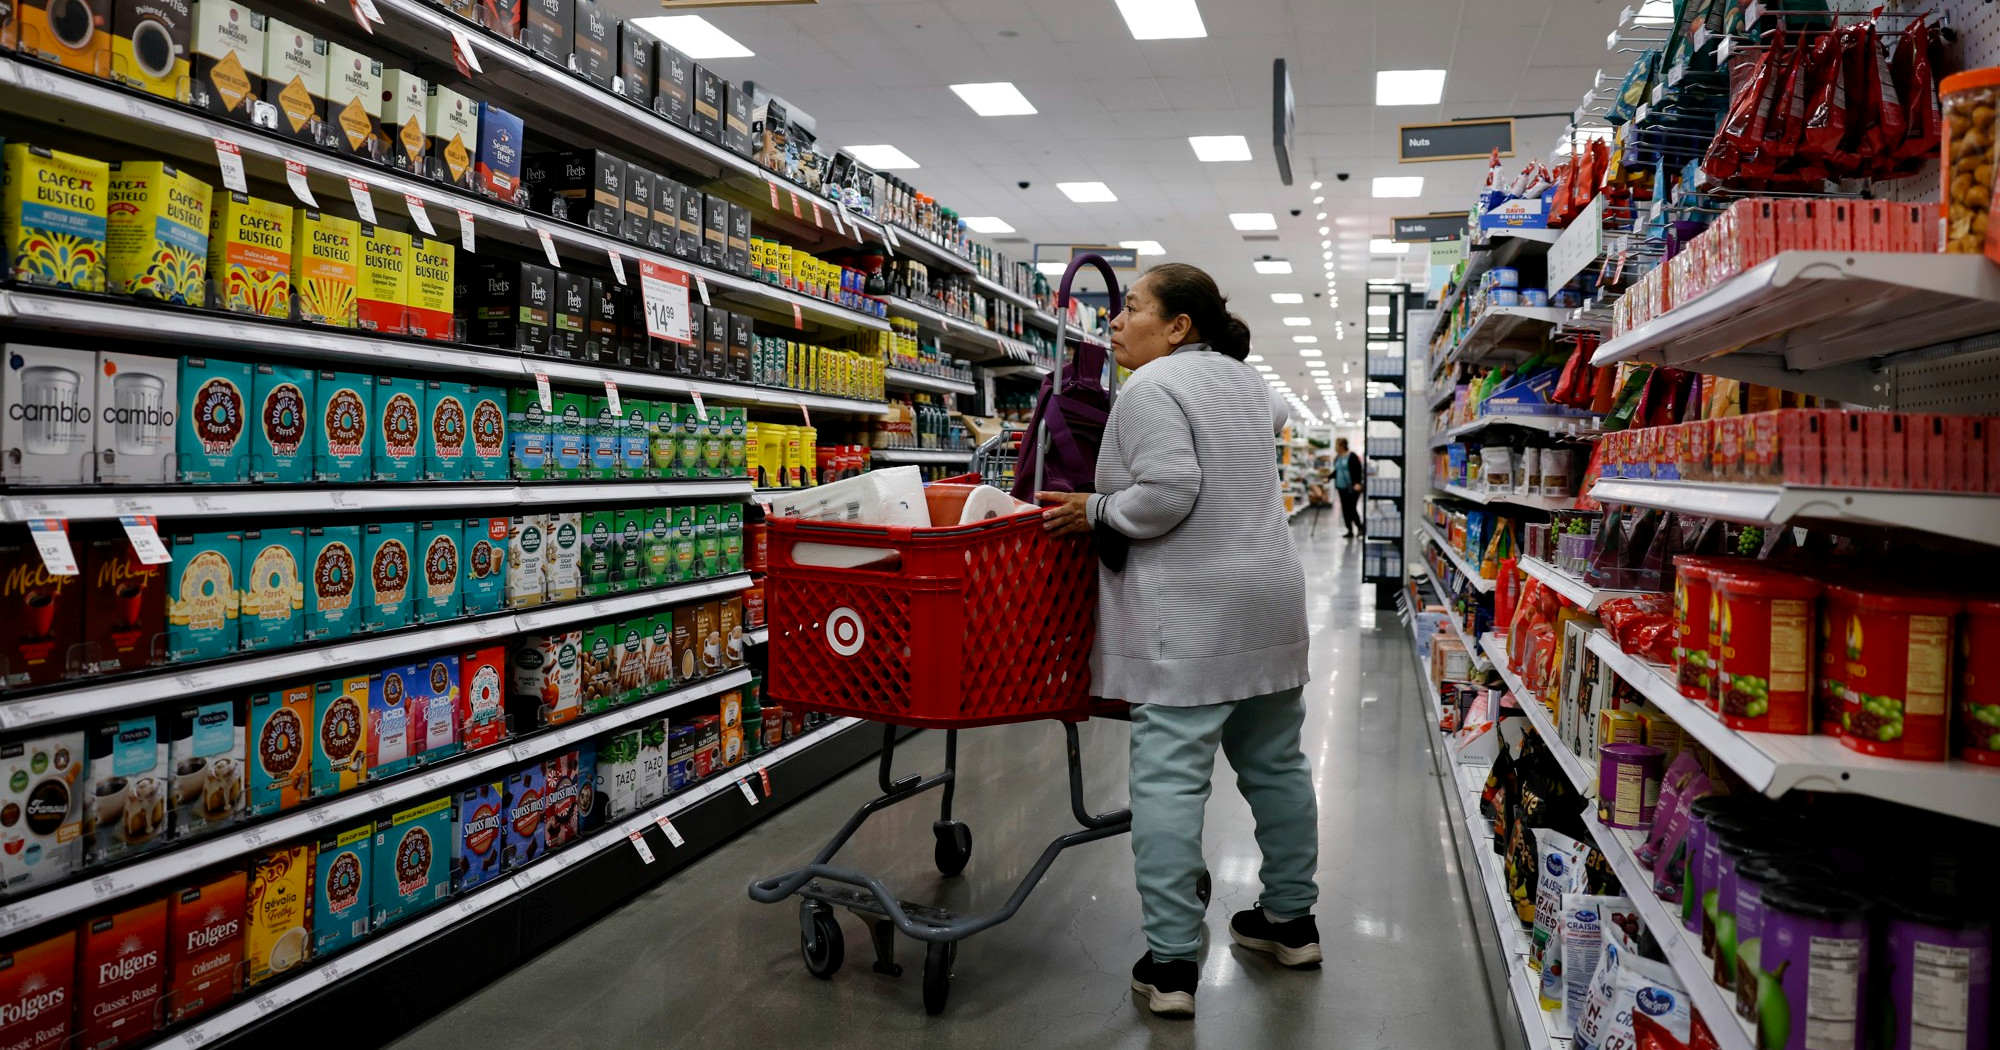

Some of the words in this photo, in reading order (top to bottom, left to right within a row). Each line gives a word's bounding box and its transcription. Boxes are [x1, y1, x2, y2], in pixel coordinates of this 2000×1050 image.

[1409, 138, 1430, 146] Nuts
[398, 155, 406, 164] 24
[497, 151, 511, 164] Best
[526, 168, 545, 180] Peet's
[566, 165, 585, 176] Peet's
[605, 169, 618, 188] Peet's
[38, 186, 95, 210] BUSTELO
[635, 181, 647, 198] Peet's
[167, 203, 203, 229] BUSTELO
[239, 229, 282, 249] BUSTELO
[313, 244, 350, 262] BUSTELO
[365, 256, 402, 272] BUSTELO
[416, 265, 449, 283] BUSTELO
[488, 279, 509, 292] Peet's
[531, 282, 546, 301] Peet's
[567, 290, 581, 308] Peet's
[601, 298, 614, 315] Peet's
[209, 385, 232, 396] ORIGINAL
[277, 389, 296, 399] ORIGINAL
[9, 402, 90, 423] cambio
[104, 406, 173, 426] cambio
[203, 393, 224, 422] DONUT
[224, 396, 235, 423] SHOP
[272, 398, 288, 424] DONUT
[288, 400, 299, 426] SHOP
[333, 402, 347, 428] DONUT
[347, 403, 359, 429] SHOP
[390, 406, 402, 430] DONUT
[403, 407, 414, 431] SHOP
[207, 423, 230, 434] COFFEE
[276, 426, 296, 436] COFFEE
[337, 430, 356, 439] COFFEE
[393, 431, 410, 440] COFFEE
[203, 439, 233, 457] DARK
[272, 442, 298, 456] DARK
[328, 440, 362, 459] Regular
[386, 443, 416, 460] Regular
[435, 443, 463, 460] Regular
[476, 443, 502, 460] Regular
[492, 525, 505, 534] LATTE
[323, 555, 336, 582] DONUT
[337, 556, 348, 581] SHOP
[379, 553, 392, 578] DONUT
[392, 554, 403, 578] SHOP
[375, 589, 405, 606] DECAF
[427, 583, 455, 598] DECAF
[317, 597, 351, 612] DECAF
[430, 696, 450, 708] ICED
[383, 708, 404, 721] ICED
[329, 711, 344, 738] DONUT
[344, 711, 355, 733] SHOP
[268, 725, 283, 752] DONUT
[283, 725, 296, 748] SHOP
[332, 735, 352, 745] COFFEE
[706, 733, 719, 743] COFFEE
[272, 750, 292, 761] COFFEE
[644, 755, 664, 773] TAZO
[616, 769, 636, 787] TAZO
[548, 792, 566, 806] SWISS
[566, 785, 577, 798] MISS
[28, 798, 68, 815] Famous
[511, 805, 530, 822] SWISS
[530, 798, 544, 812] MISS
[464, 820, 484, 838] SWISS
[485, 814, 500, 828] MISS
[406, 833, 423, 844] ORIGINAL
[403, 842, 416, 869] DONUT
[416, 841, 426, 862] SHOP
[333, 864, 347, 889] DONUT
[347, 864, 356, 884] SHOP
[406, 865, 422, 877] COFFEE
[399, 875, 428, 896] Regular
[330, 894, 358, 914] Regular
[376, 908, 386, 926] 60
[1567, 922, 1600, 930] CRAISIN
[188, 919, 238, 950] Folgers
[99, 950, 157, 984] Folgers
[192, 953, 231, 977] Colombian
[0, 987, 64, 1026] Folgers
[93, 993, 129, 1017] Classic
[132, 983, 158, 1002] Roast
[35, 1022, 65, 1044] Roast
